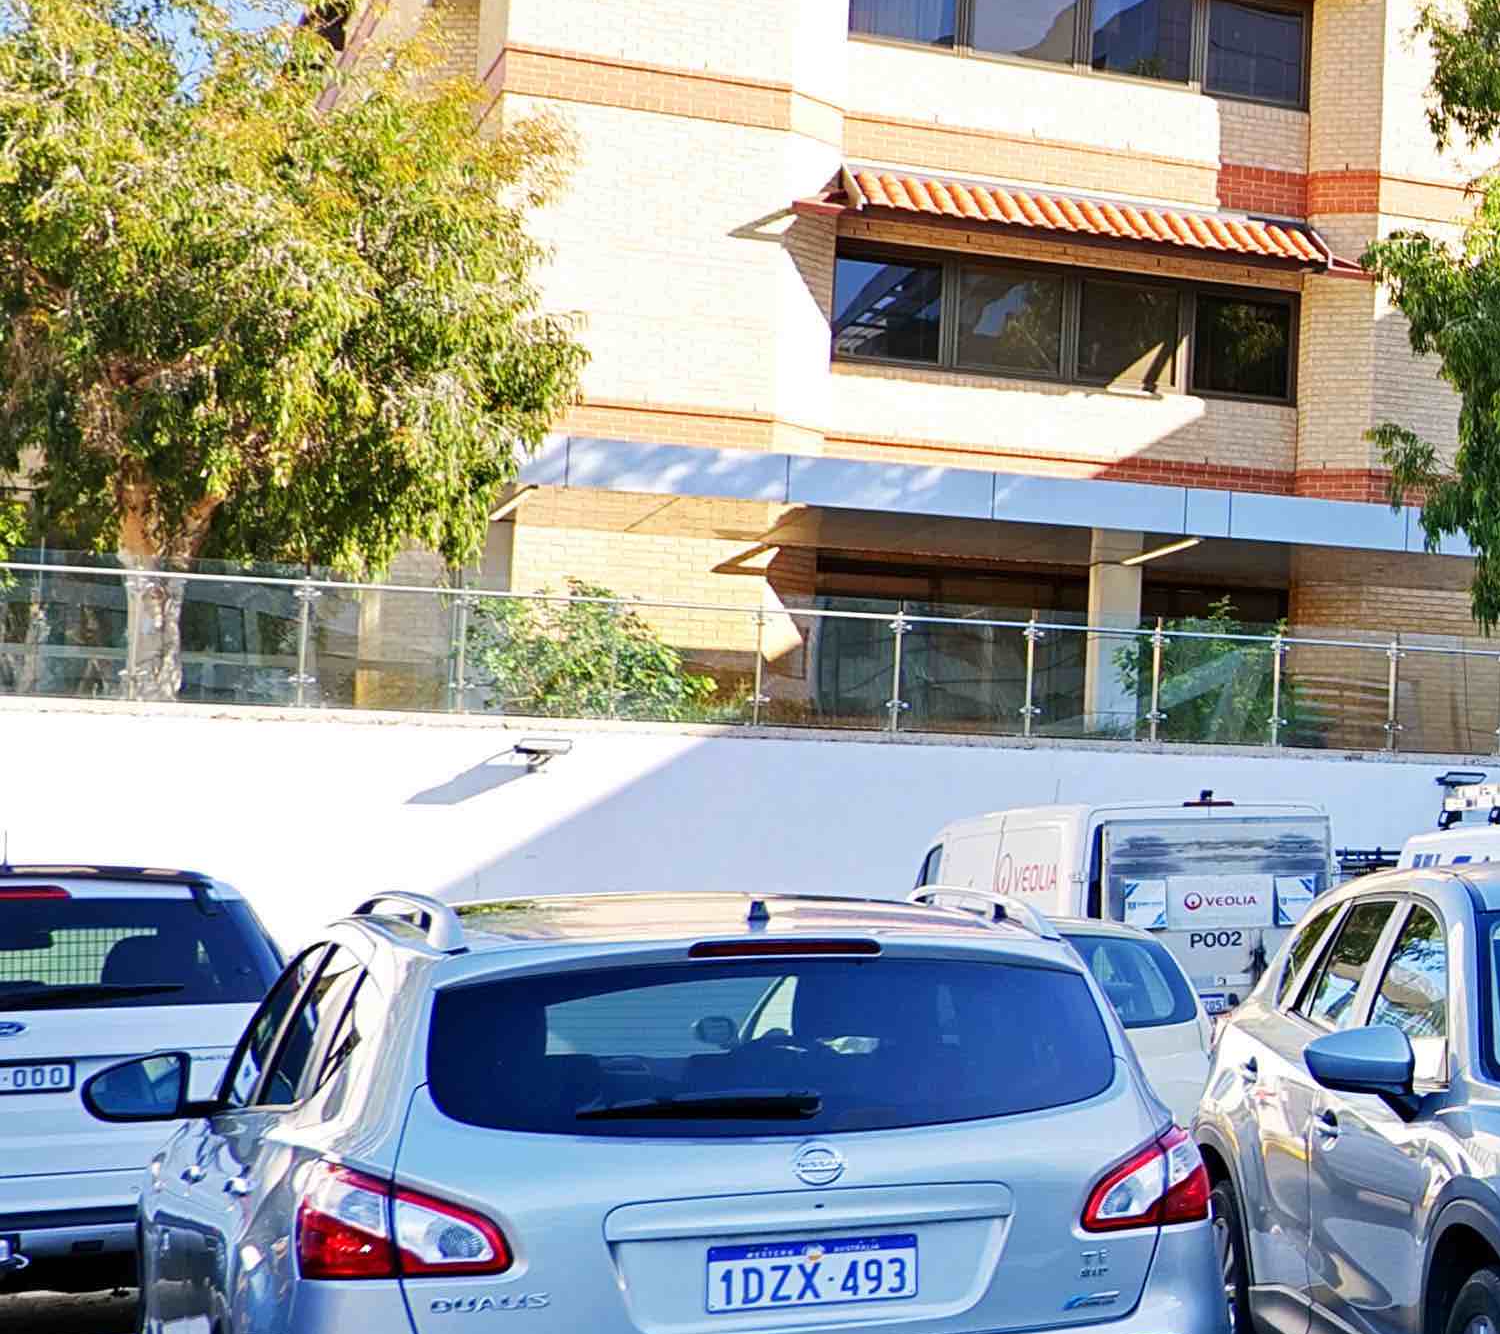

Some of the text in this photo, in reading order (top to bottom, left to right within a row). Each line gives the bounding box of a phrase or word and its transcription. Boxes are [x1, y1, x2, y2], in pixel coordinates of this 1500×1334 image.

[1013, 862, 1057, 892] VEOLIA
[1205, 895, 1257, 907] VEOLIA
[1190, 931, 1242, 948] P002
